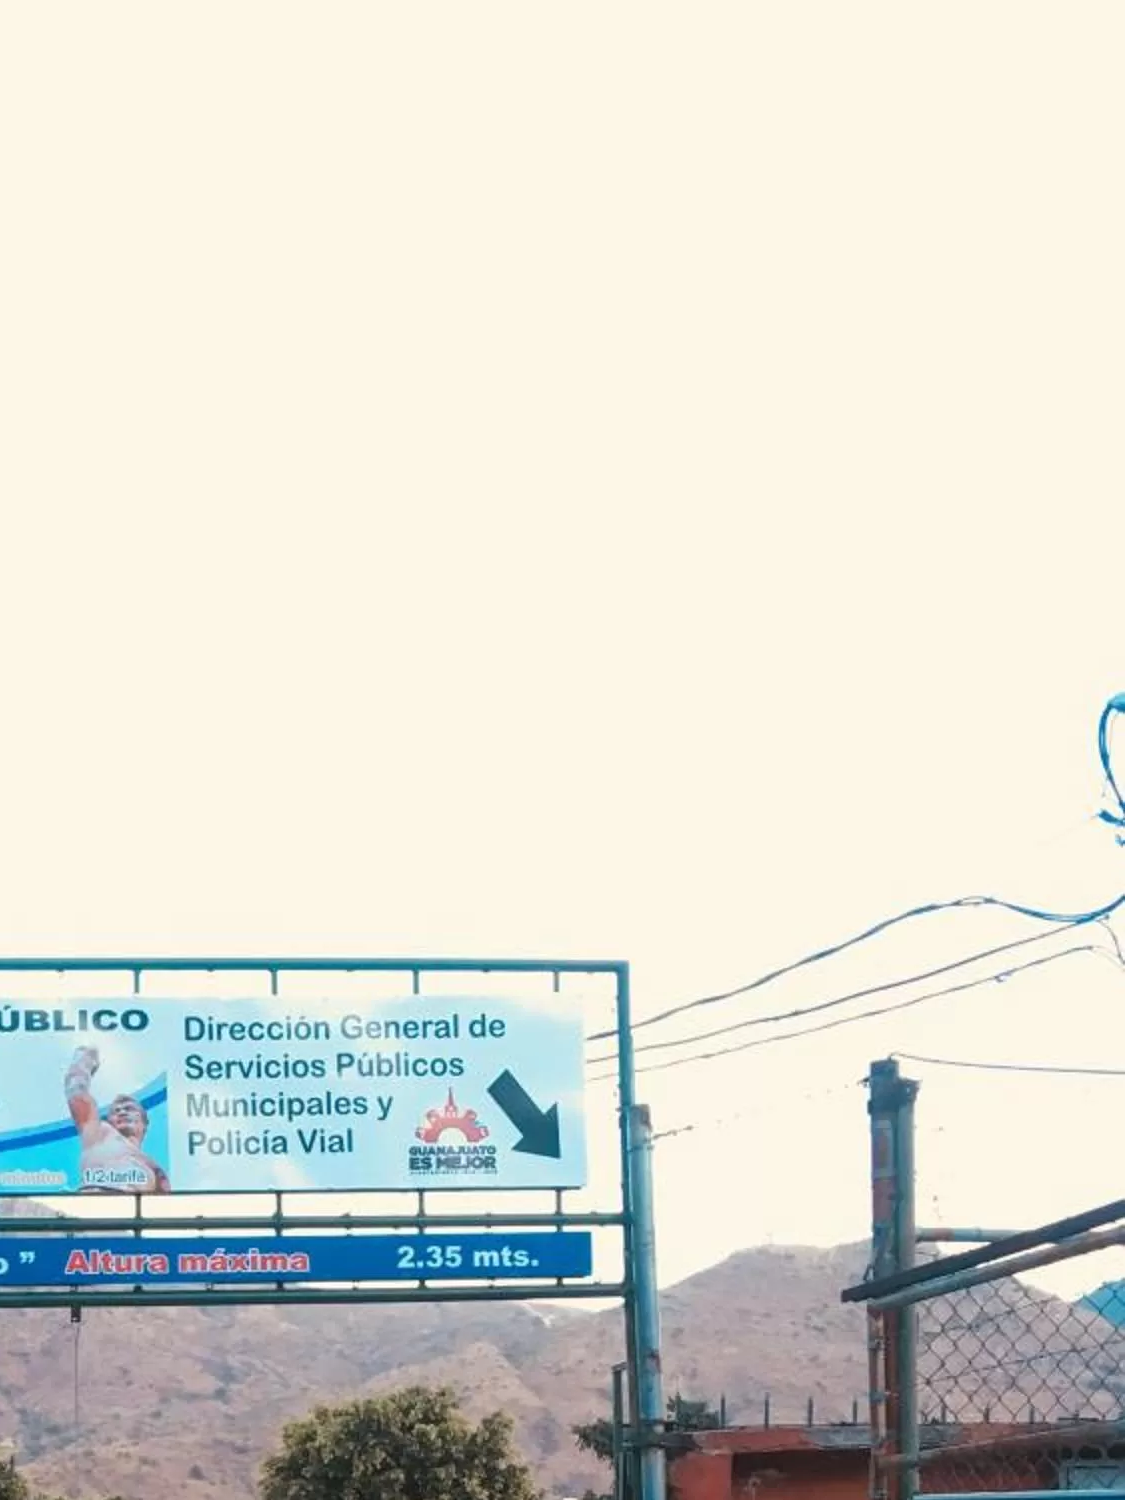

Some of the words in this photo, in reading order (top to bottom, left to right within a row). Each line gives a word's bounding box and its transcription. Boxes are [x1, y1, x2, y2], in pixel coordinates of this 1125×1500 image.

[183, 1015, 331, 1041] Dirección
[340, 1014, 460, 1040] General
[469, 1013, 506, 1038] de
[184, 1052, 327, 1080] Servicios
[336, 1051, 465, 1078] Públicos
[185, 1091, 368, 1122] Municipales
[376, 1096, 393, 1121] y
[187, 1130, 288, 1155] Policía
[296, 1128, 354, 1154] Vial
[408, 1145, 497, 1156] GUANAJUATO
[409, 1157, 432, 1170] ES
[436, 1156, 497, 1169] MEJOR
[65, 1249, 169, 1275] Altura
[178, 1246, 310, 1273] máxima
[397, 1245, 463, 1269] 2.35
[474, 1246, 540, 1268] mts.
